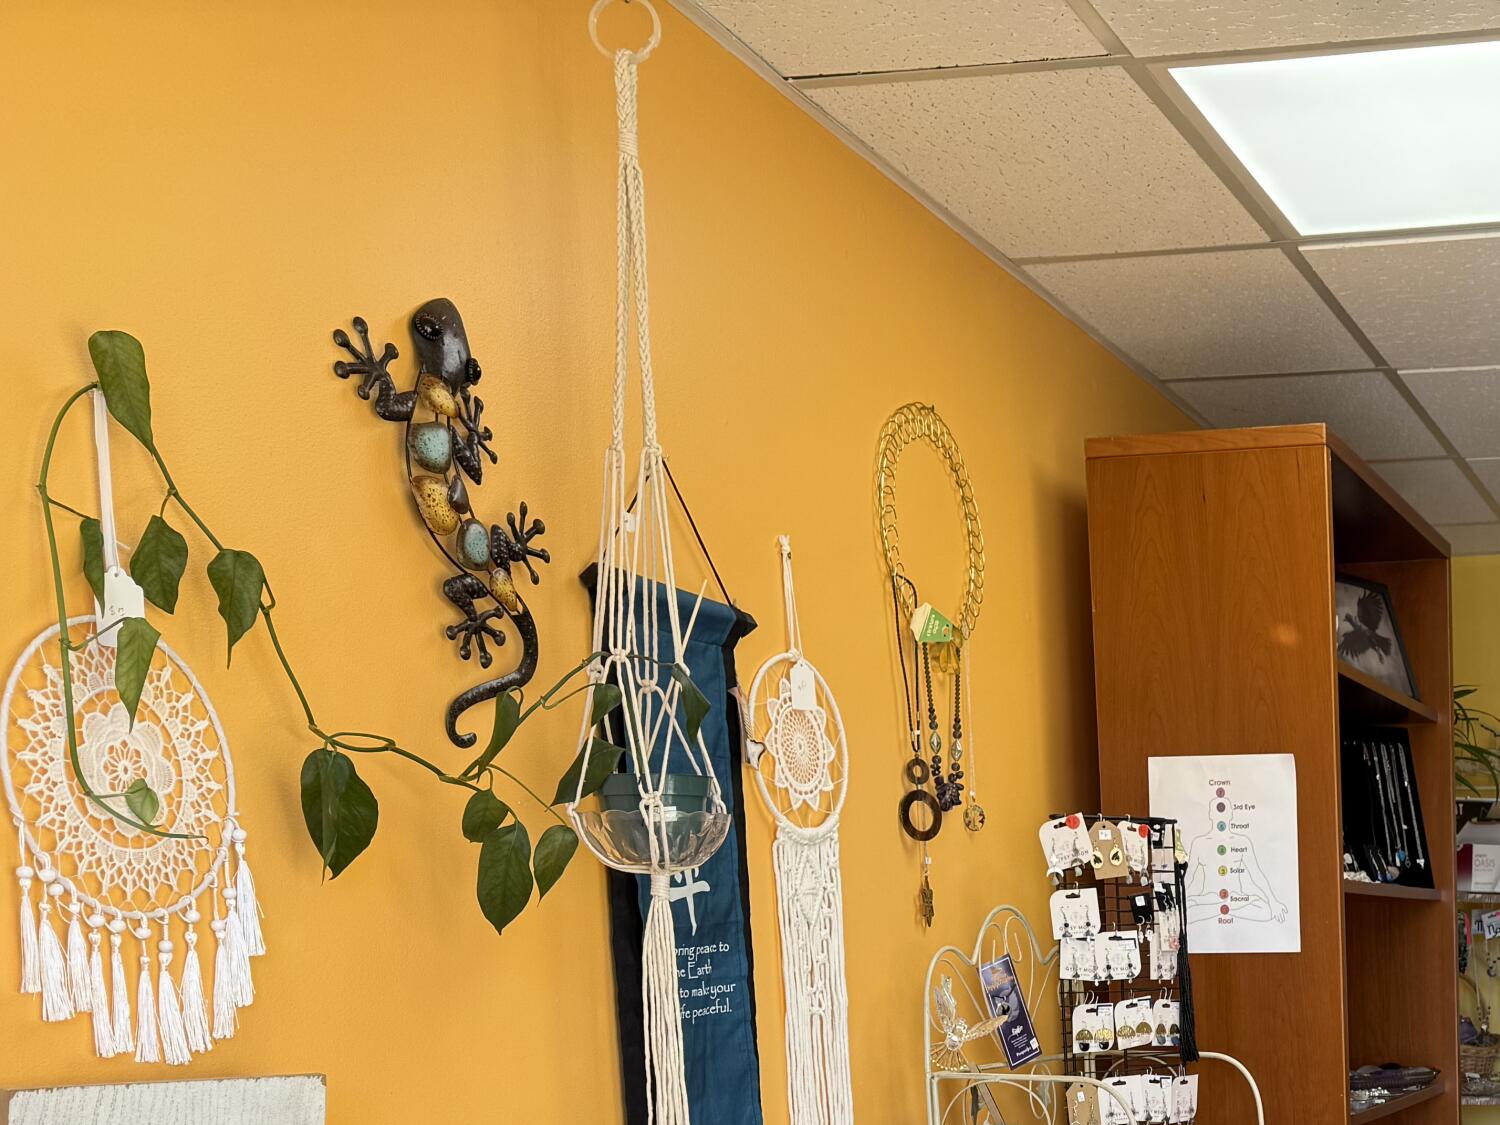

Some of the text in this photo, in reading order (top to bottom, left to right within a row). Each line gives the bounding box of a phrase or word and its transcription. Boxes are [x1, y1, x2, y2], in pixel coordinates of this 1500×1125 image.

[696, 944, 716, 961] peace
[719, 941, 730, 953] to
[676, 959, 712, 980] he Earth
[679, 982, 737, 1001] to make your
[679, 998, 733, 1025] ife peaceful.
